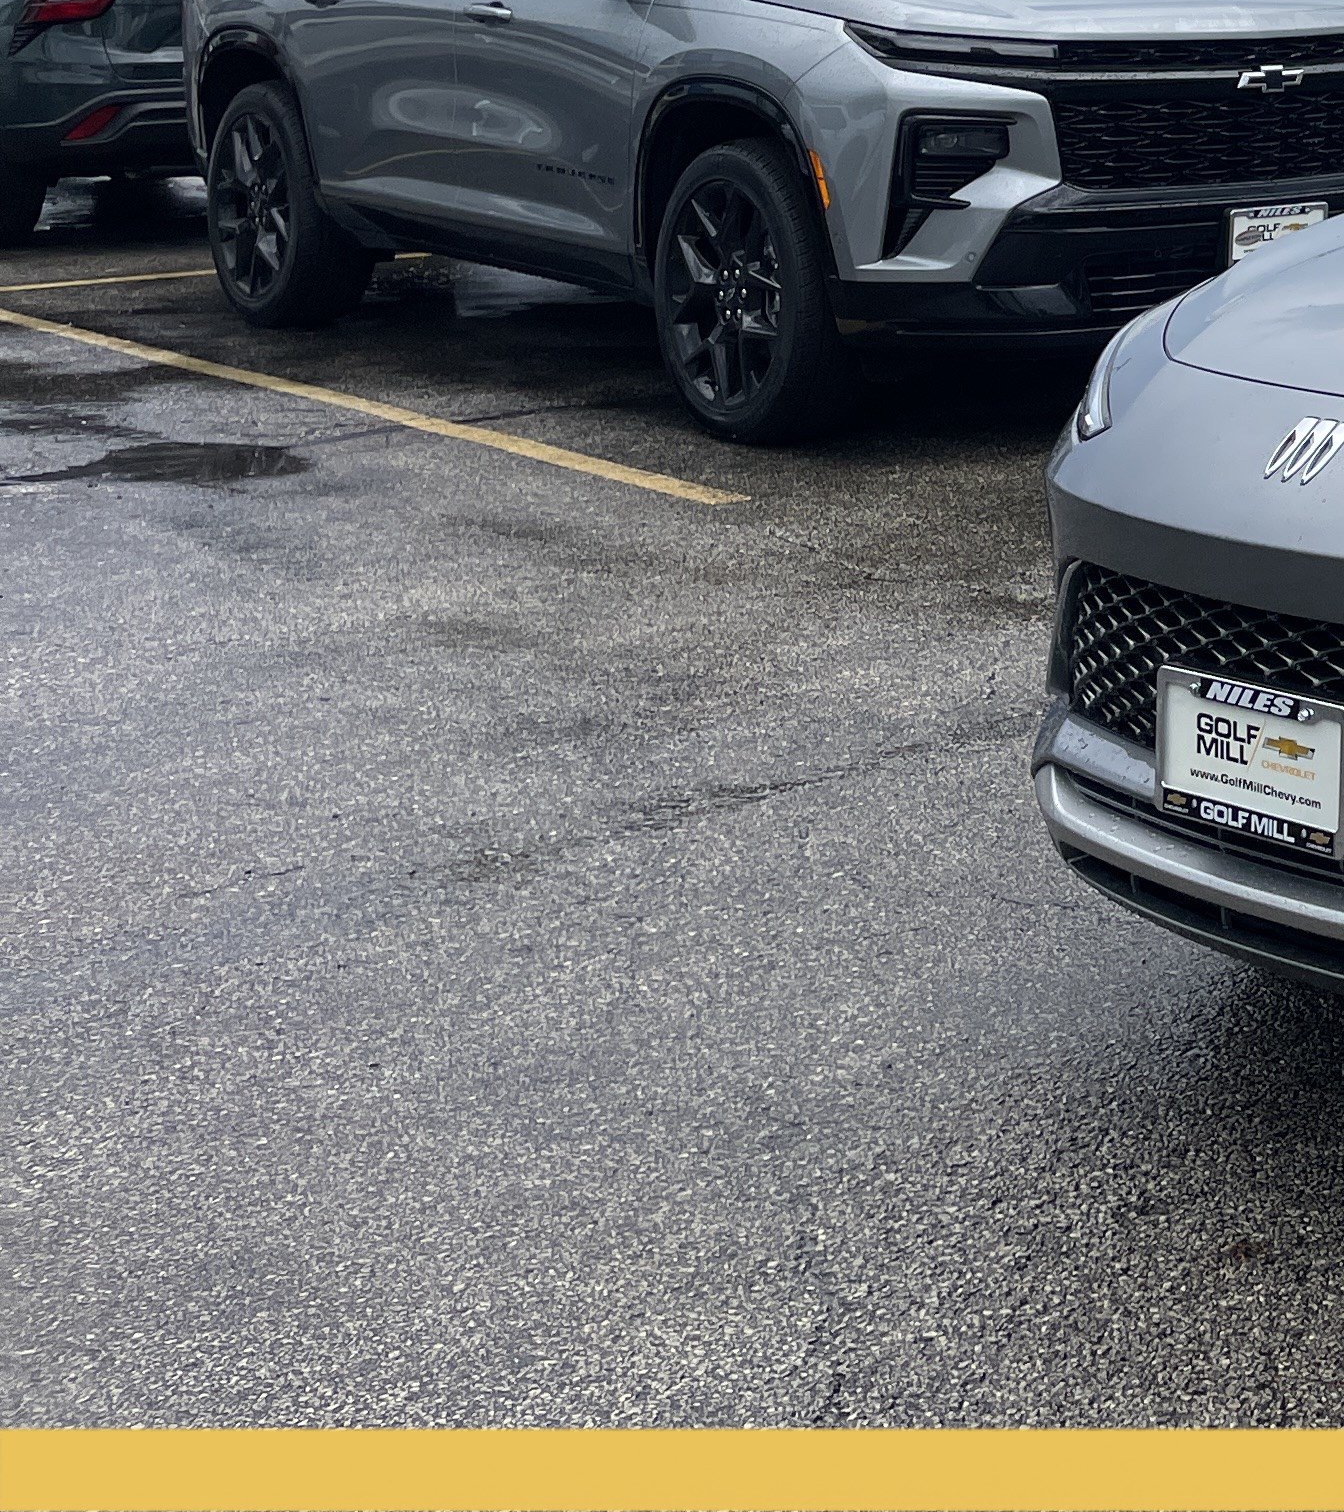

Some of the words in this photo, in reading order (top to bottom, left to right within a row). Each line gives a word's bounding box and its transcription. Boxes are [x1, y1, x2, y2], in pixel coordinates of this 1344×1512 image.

[1206, 681, 1294, 716] NILES
[1196, 712, 1260, 745] GOLF
[1196, 733, 1249, 765] MILL
[1261, 760, 1316, 781] CHEVROLET
[1190, 768, 1322, 810] www.GolfMillChevy.com
[1201, 801, 1249, 829] GOLF
[1251, 814, 1295, 843] MILL
